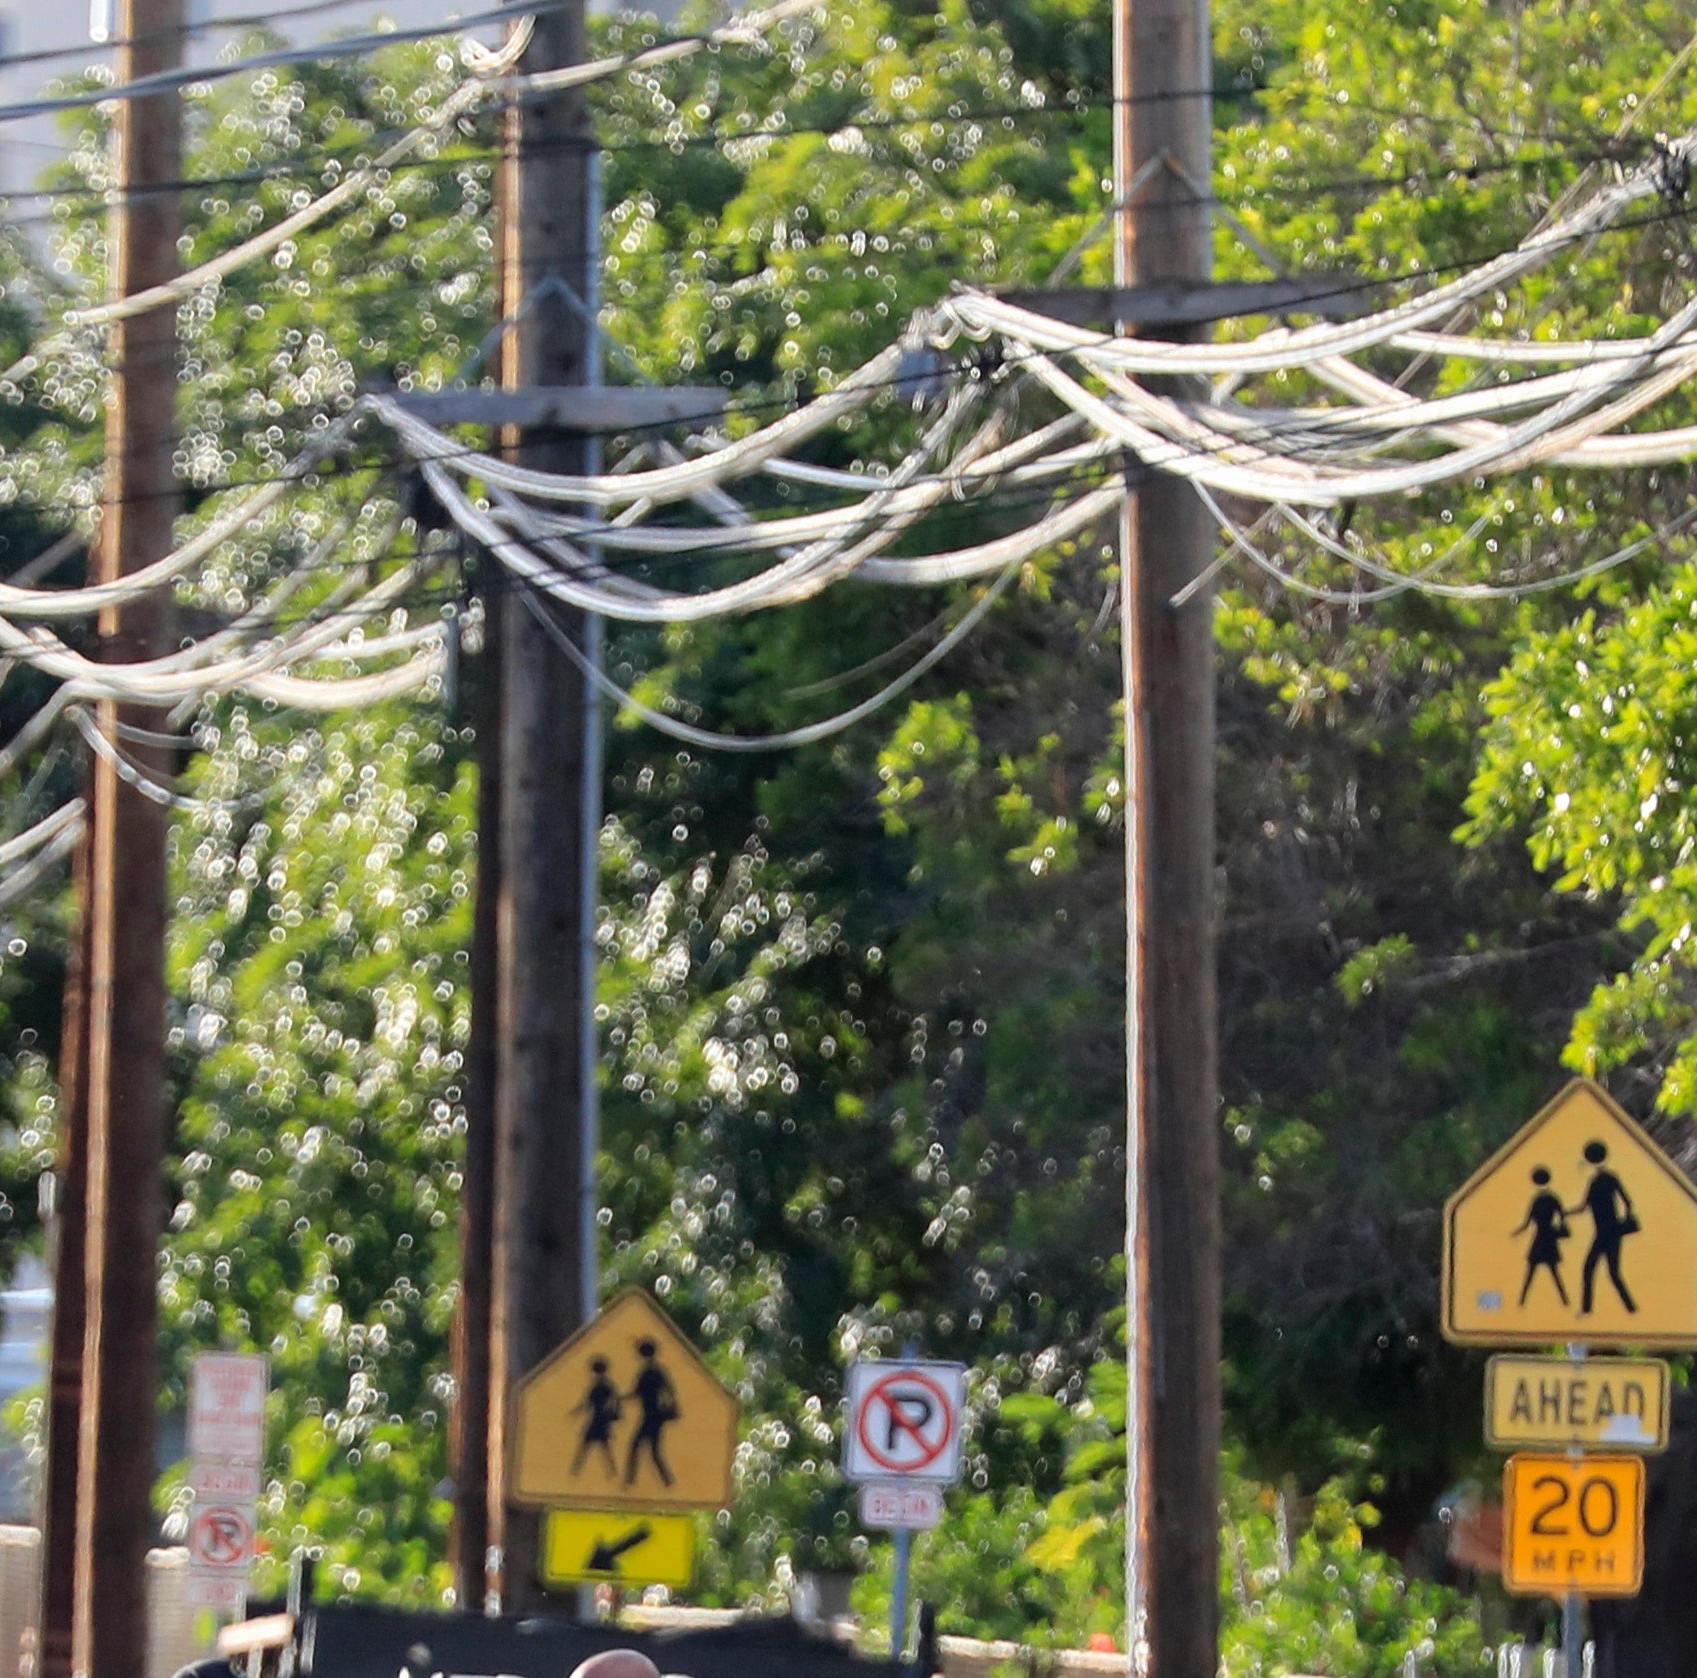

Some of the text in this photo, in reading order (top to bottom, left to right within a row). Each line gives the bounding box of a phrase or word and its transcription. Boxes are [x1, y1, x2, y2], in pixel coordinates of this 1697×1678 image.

[1509, 1377, 1646, 1426] AHEAD
[1530, 1476, 1619, 1537] 20
[1532, 1549, 1615, 1573] MPH
